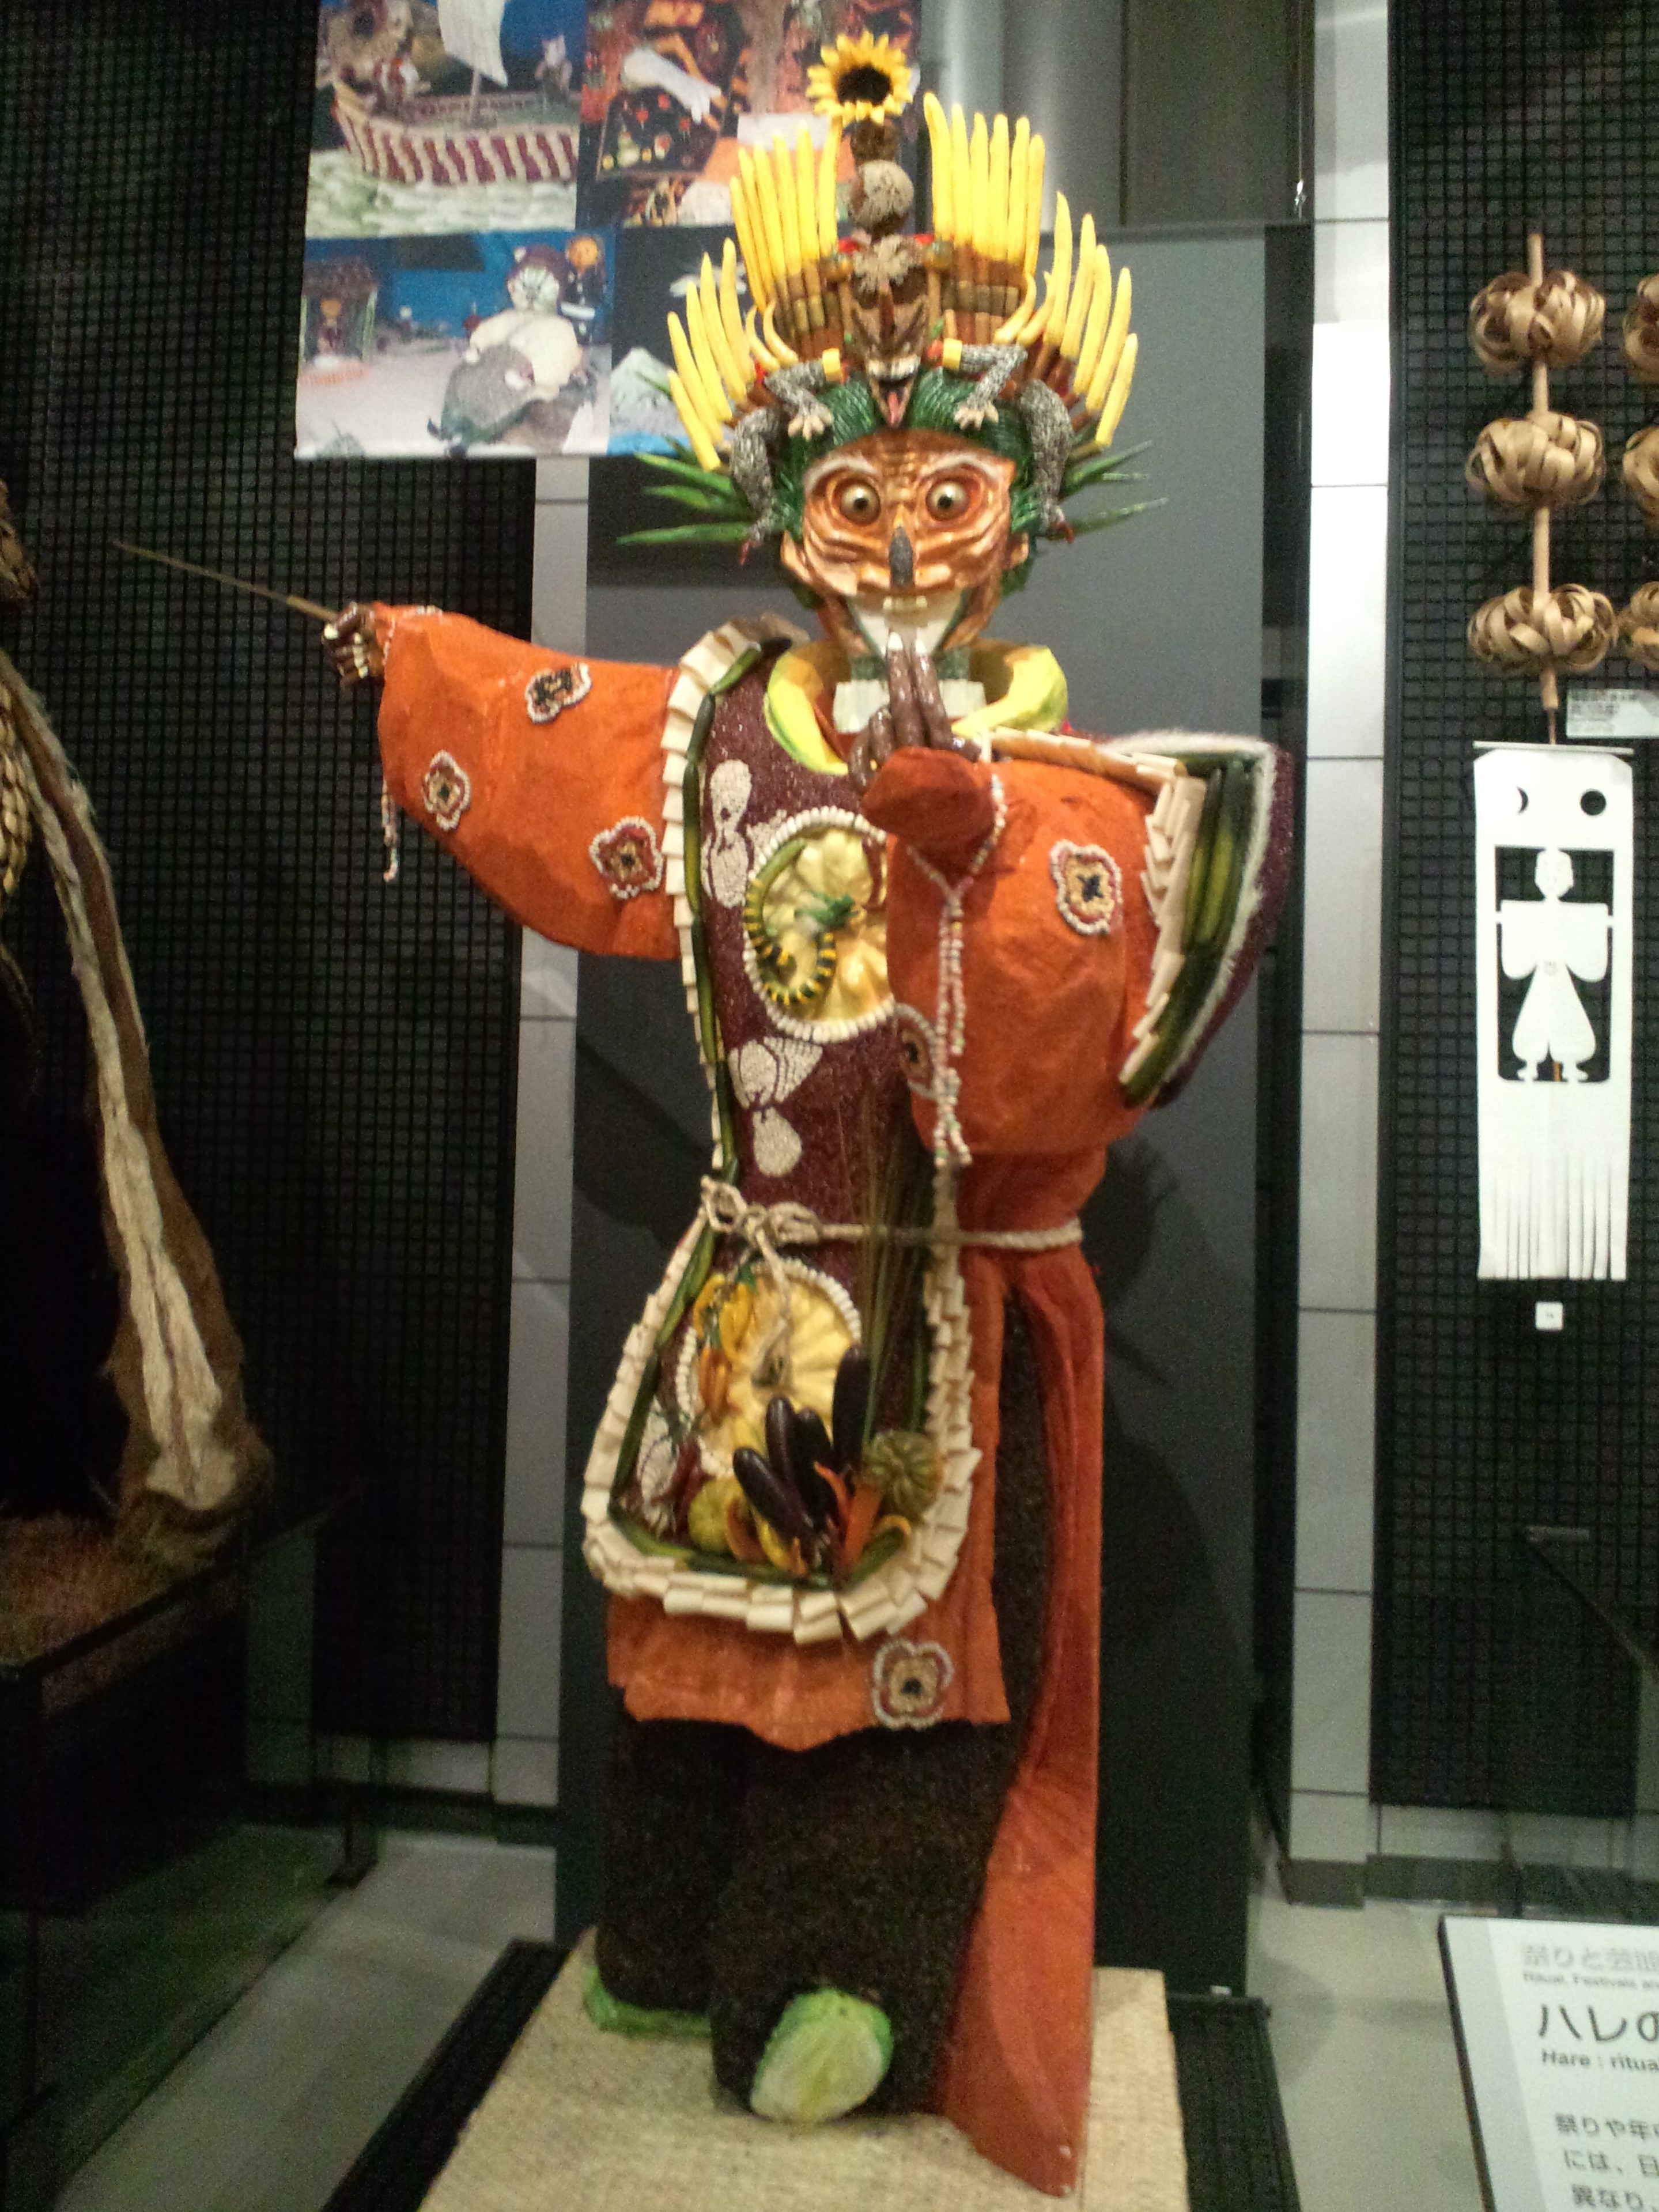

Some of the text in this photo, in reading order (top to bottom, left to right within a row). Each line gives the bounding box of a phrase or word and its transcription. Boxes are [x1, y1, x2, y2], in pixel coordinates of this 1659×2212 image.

[1541, 2050, 1591, 2067] Hare
[1556, 2112, 1659, 2141] 祭りや年
